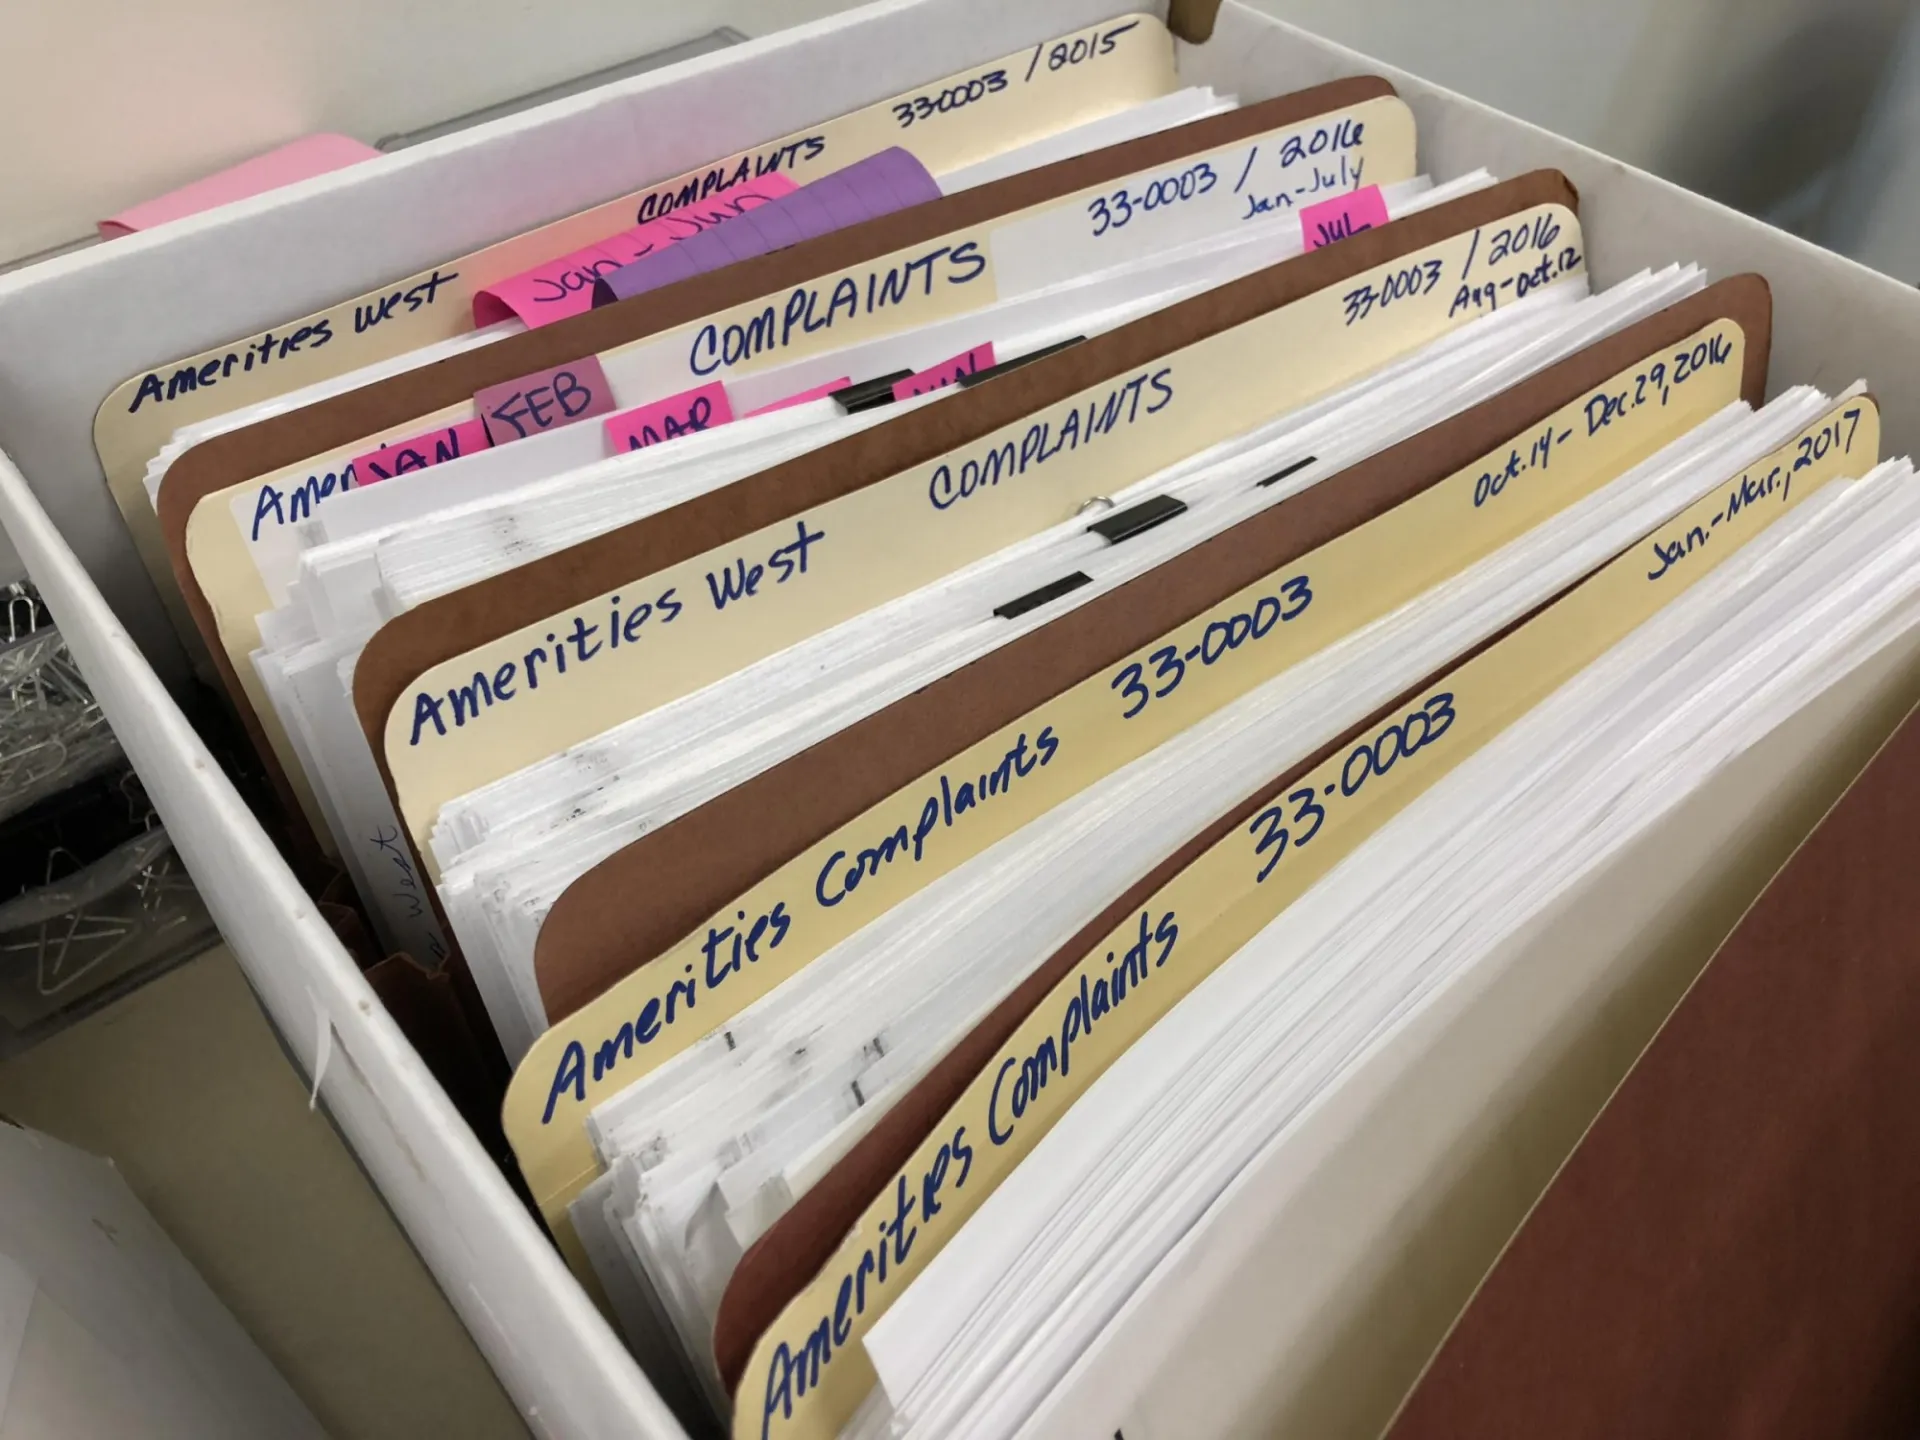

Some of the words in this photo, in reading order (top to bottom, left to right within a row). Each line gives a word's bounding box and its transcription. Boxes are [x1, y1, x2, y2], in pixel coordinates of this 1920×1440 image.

[1087, 162, 1218, 237] 33-0003
[1280, 118, 1365, 168] 2016
[1488, 212, 1561, 266] 2016
[533, 259, 624, 302] Jan
[689, 241, 987, 377] COMPLAINTS
[491, 371, 592, 439] FEB
[928, 367, 1173, 510] COMPLAINTS
[409, 596, 682, 746] Amerities
[706, 521, 825, 610] West
[542, 902, 790, 1124] Amerities
[815, 725, 1060, 907] Complaints
[1111, 575, 1313, 719] 33-0003
[988, 910, 1178, 1146] Complaints
[1249, 692, 1456, 883] 33-0003
